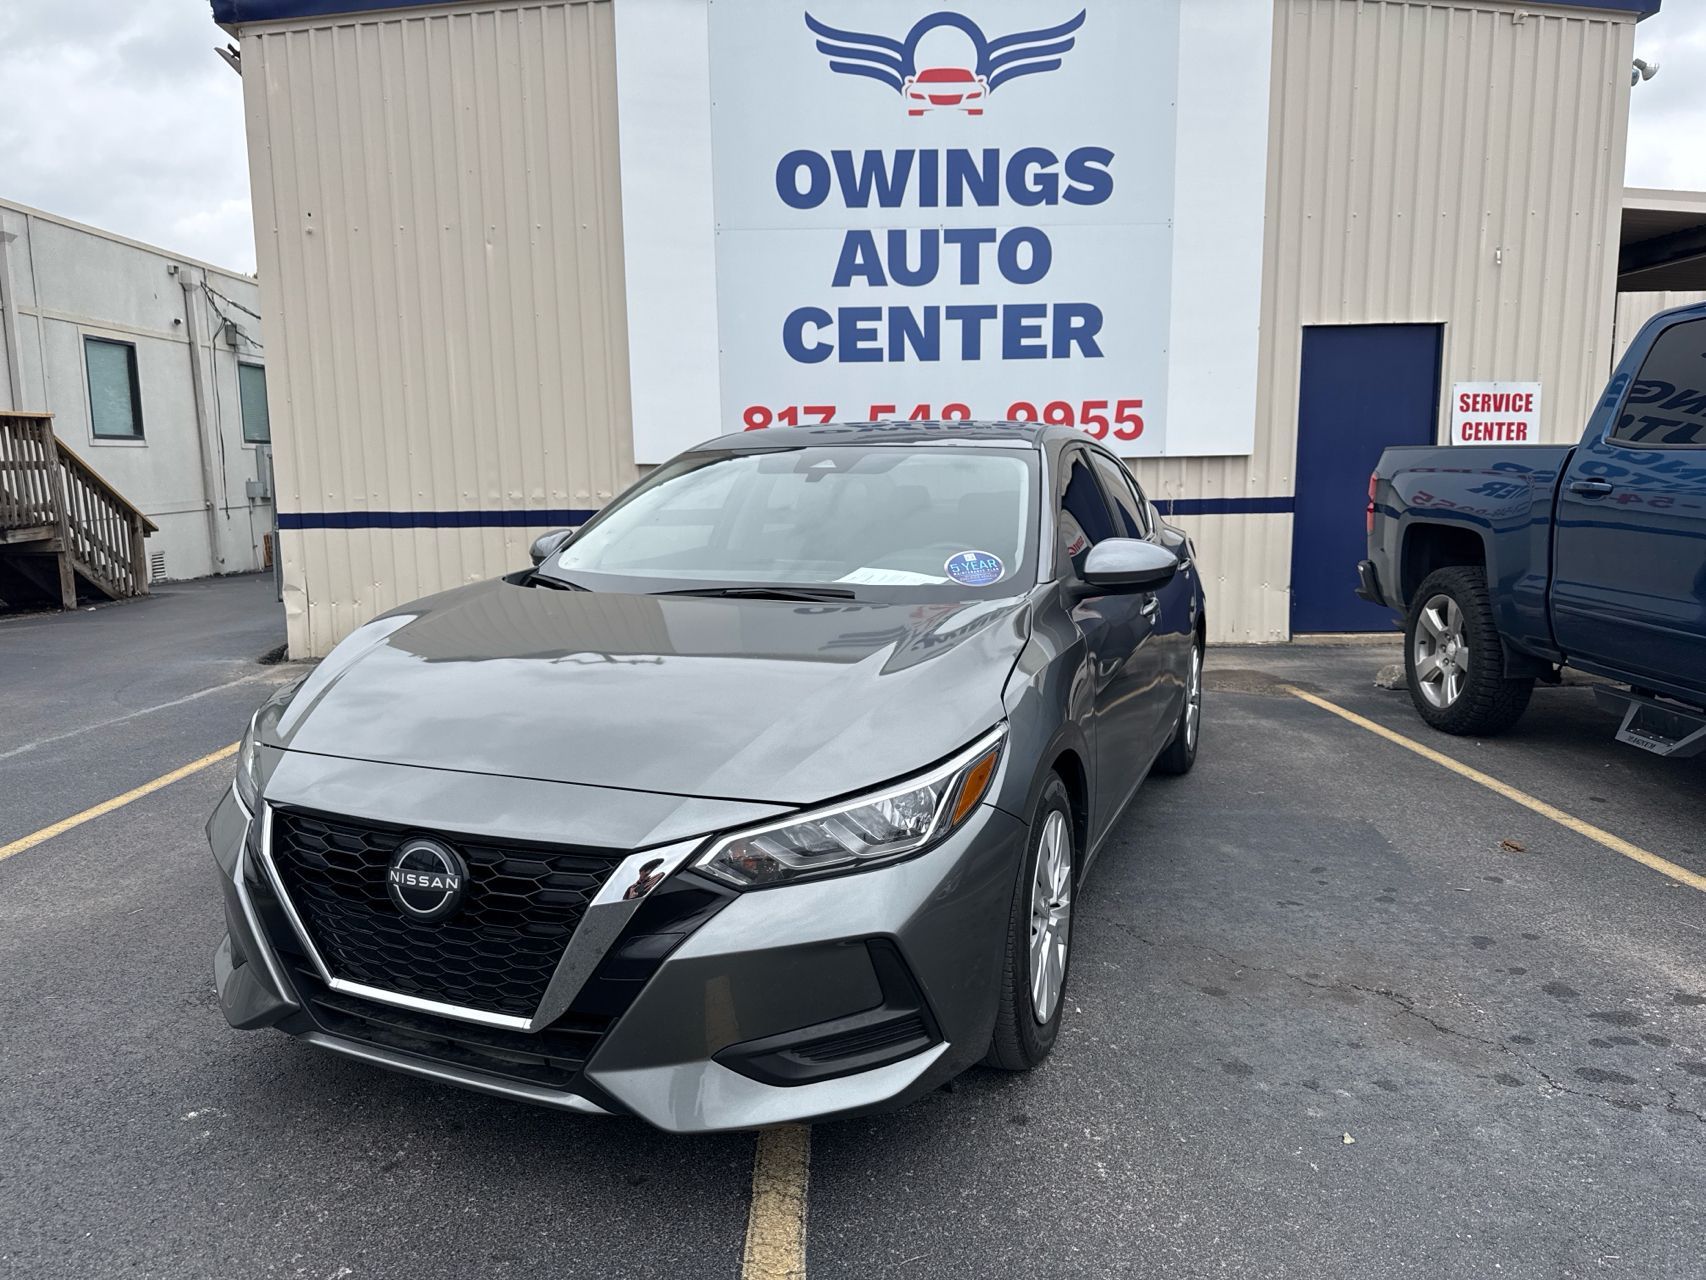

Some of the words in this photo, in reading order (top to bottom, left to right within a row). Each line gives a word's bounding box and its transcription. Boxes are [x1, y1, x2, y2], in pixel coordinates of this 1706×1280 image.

[776, 147, 1114, 209] OWINGS
[832, 227, 1051, 287] AUTO
[783, 303, 1103, 363] CENTER
[1459, 392, 1533, 413] SERVICE
[1461, 421, 1528, 442] CENTER
[950, 563, 960, 573] 5
[961, 559, 998, 570] YEAR
[390, 870, 459, 889] NISSAN
